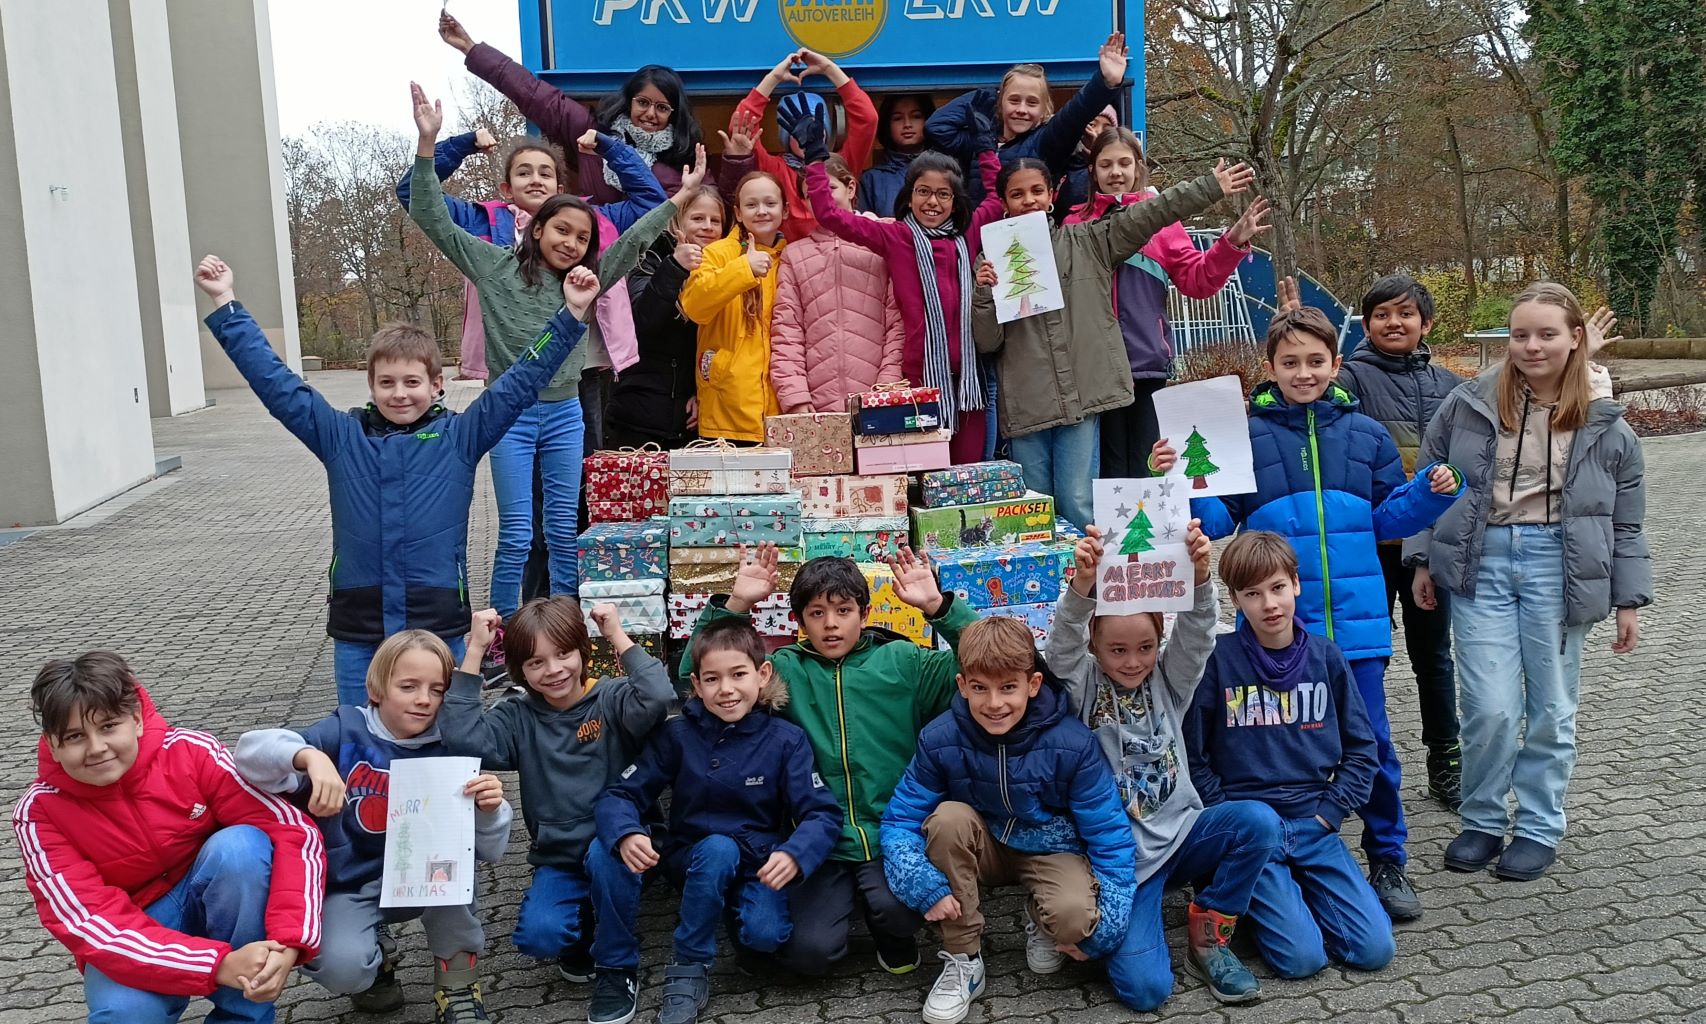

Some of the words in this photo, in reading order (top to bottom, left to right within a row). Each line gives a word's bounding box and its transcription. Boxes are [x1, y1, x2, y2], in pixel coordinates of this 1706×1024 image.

[788, 8, 875, 22] AUTOVERLEIH
[996, 502, 1049, 518] PACKSET
[1102, 560, 1177, 584] MERRY
[1225, 682, 1328, 728] NARUTO
[348, 763, 389, 792] KNI
[390, 794, 431, 823] MERRY
